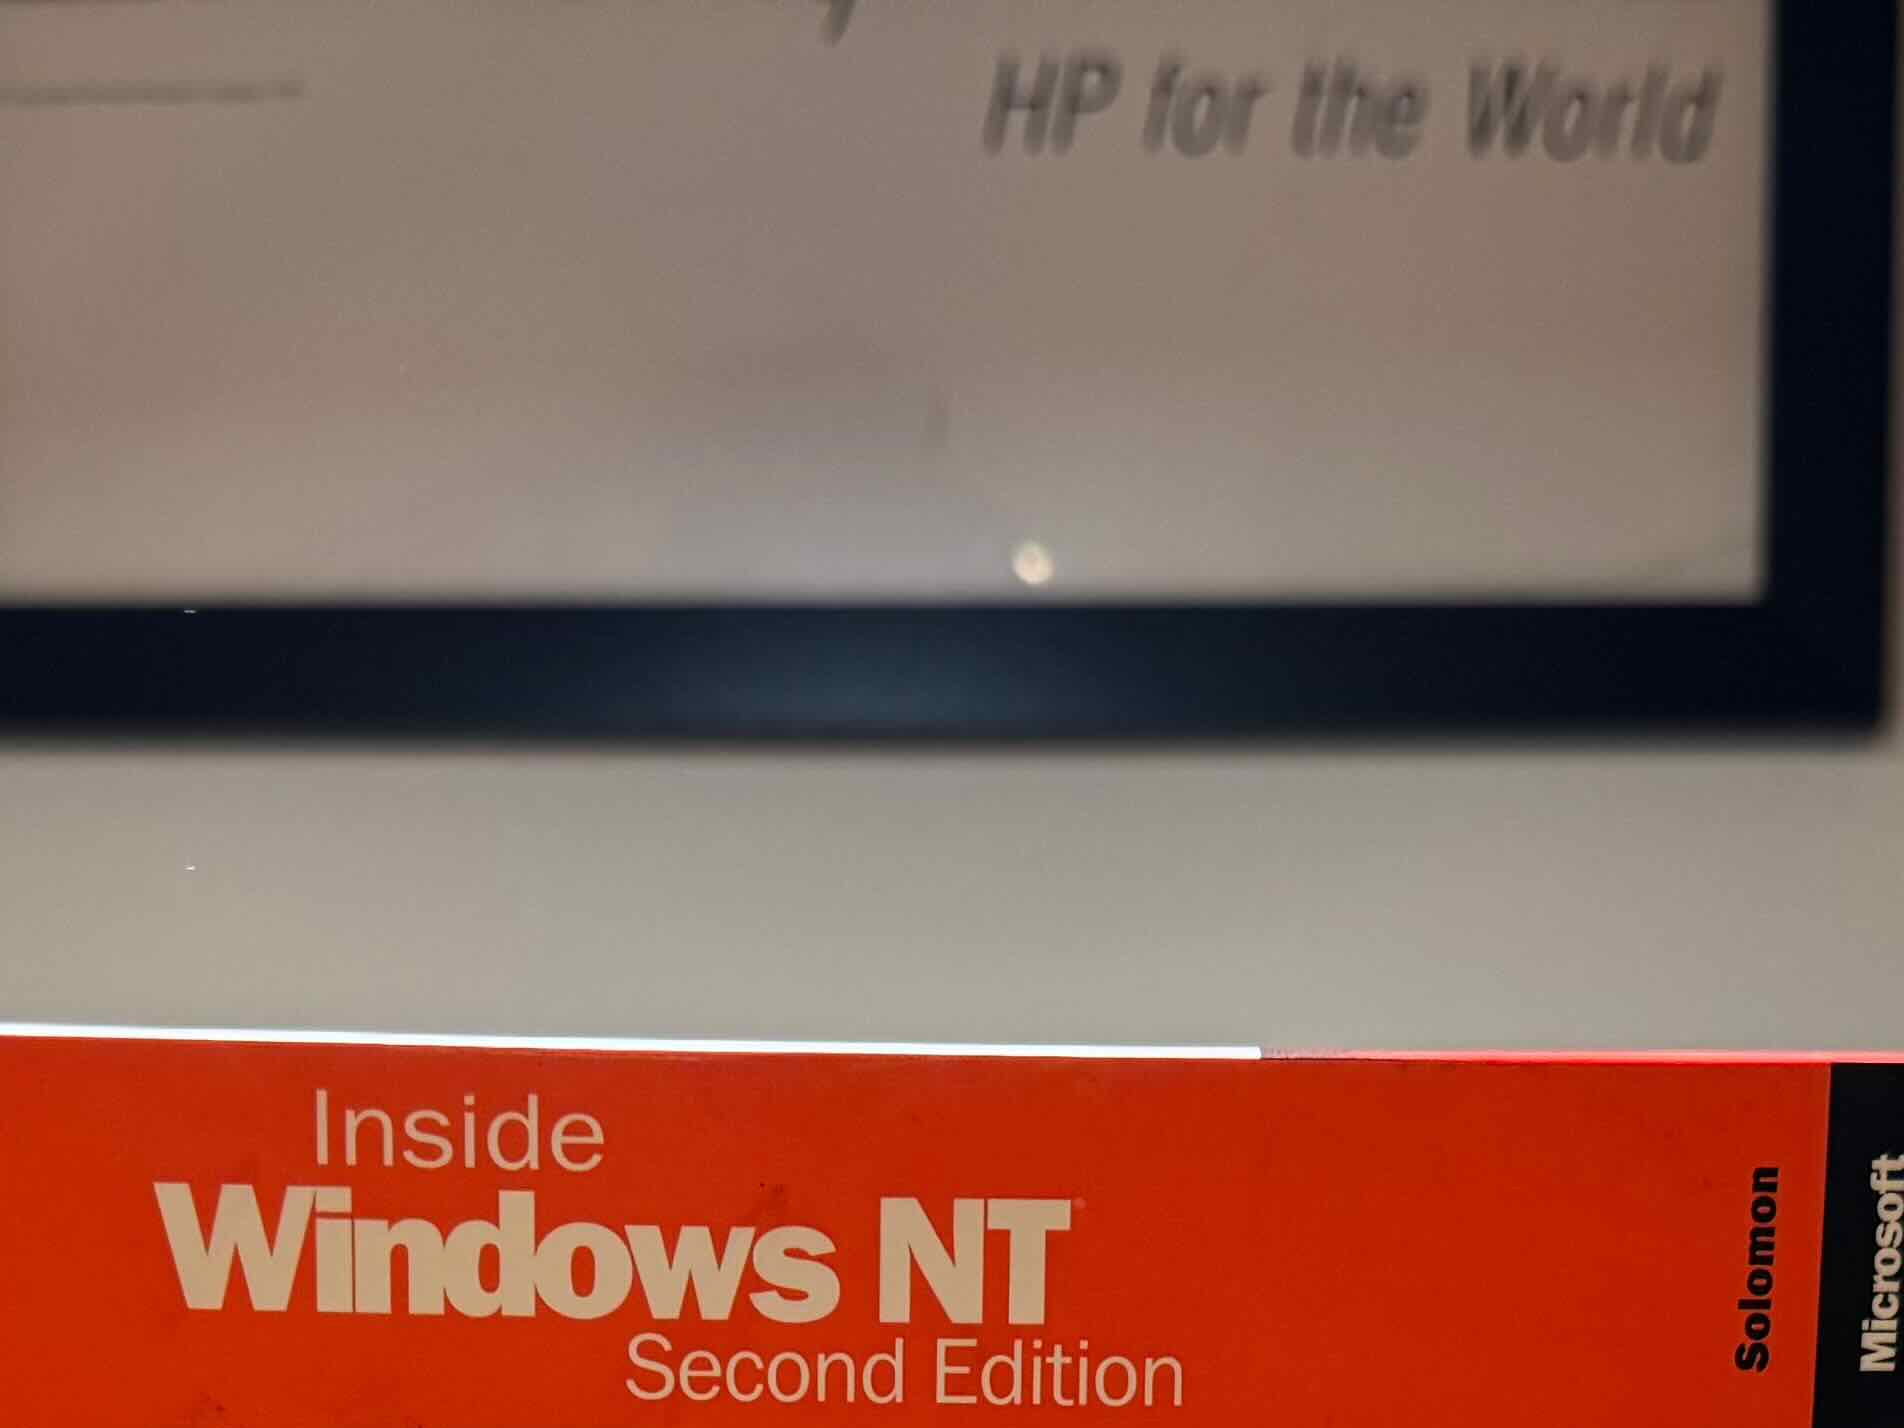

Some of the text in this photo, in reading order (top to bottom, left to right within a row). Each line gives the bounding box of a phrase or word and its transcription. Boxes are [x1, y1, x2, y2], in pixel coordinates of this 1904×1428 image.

[983, 47, 1726, 165] HP for the World
[314, 1088, 605, 1171] Inside
[153, 1181, 1073, 1325] Windows NT
[1735, 1167, 1779, 1373] Solomon
[624, 1331, 1183, 1407] Second Edition
